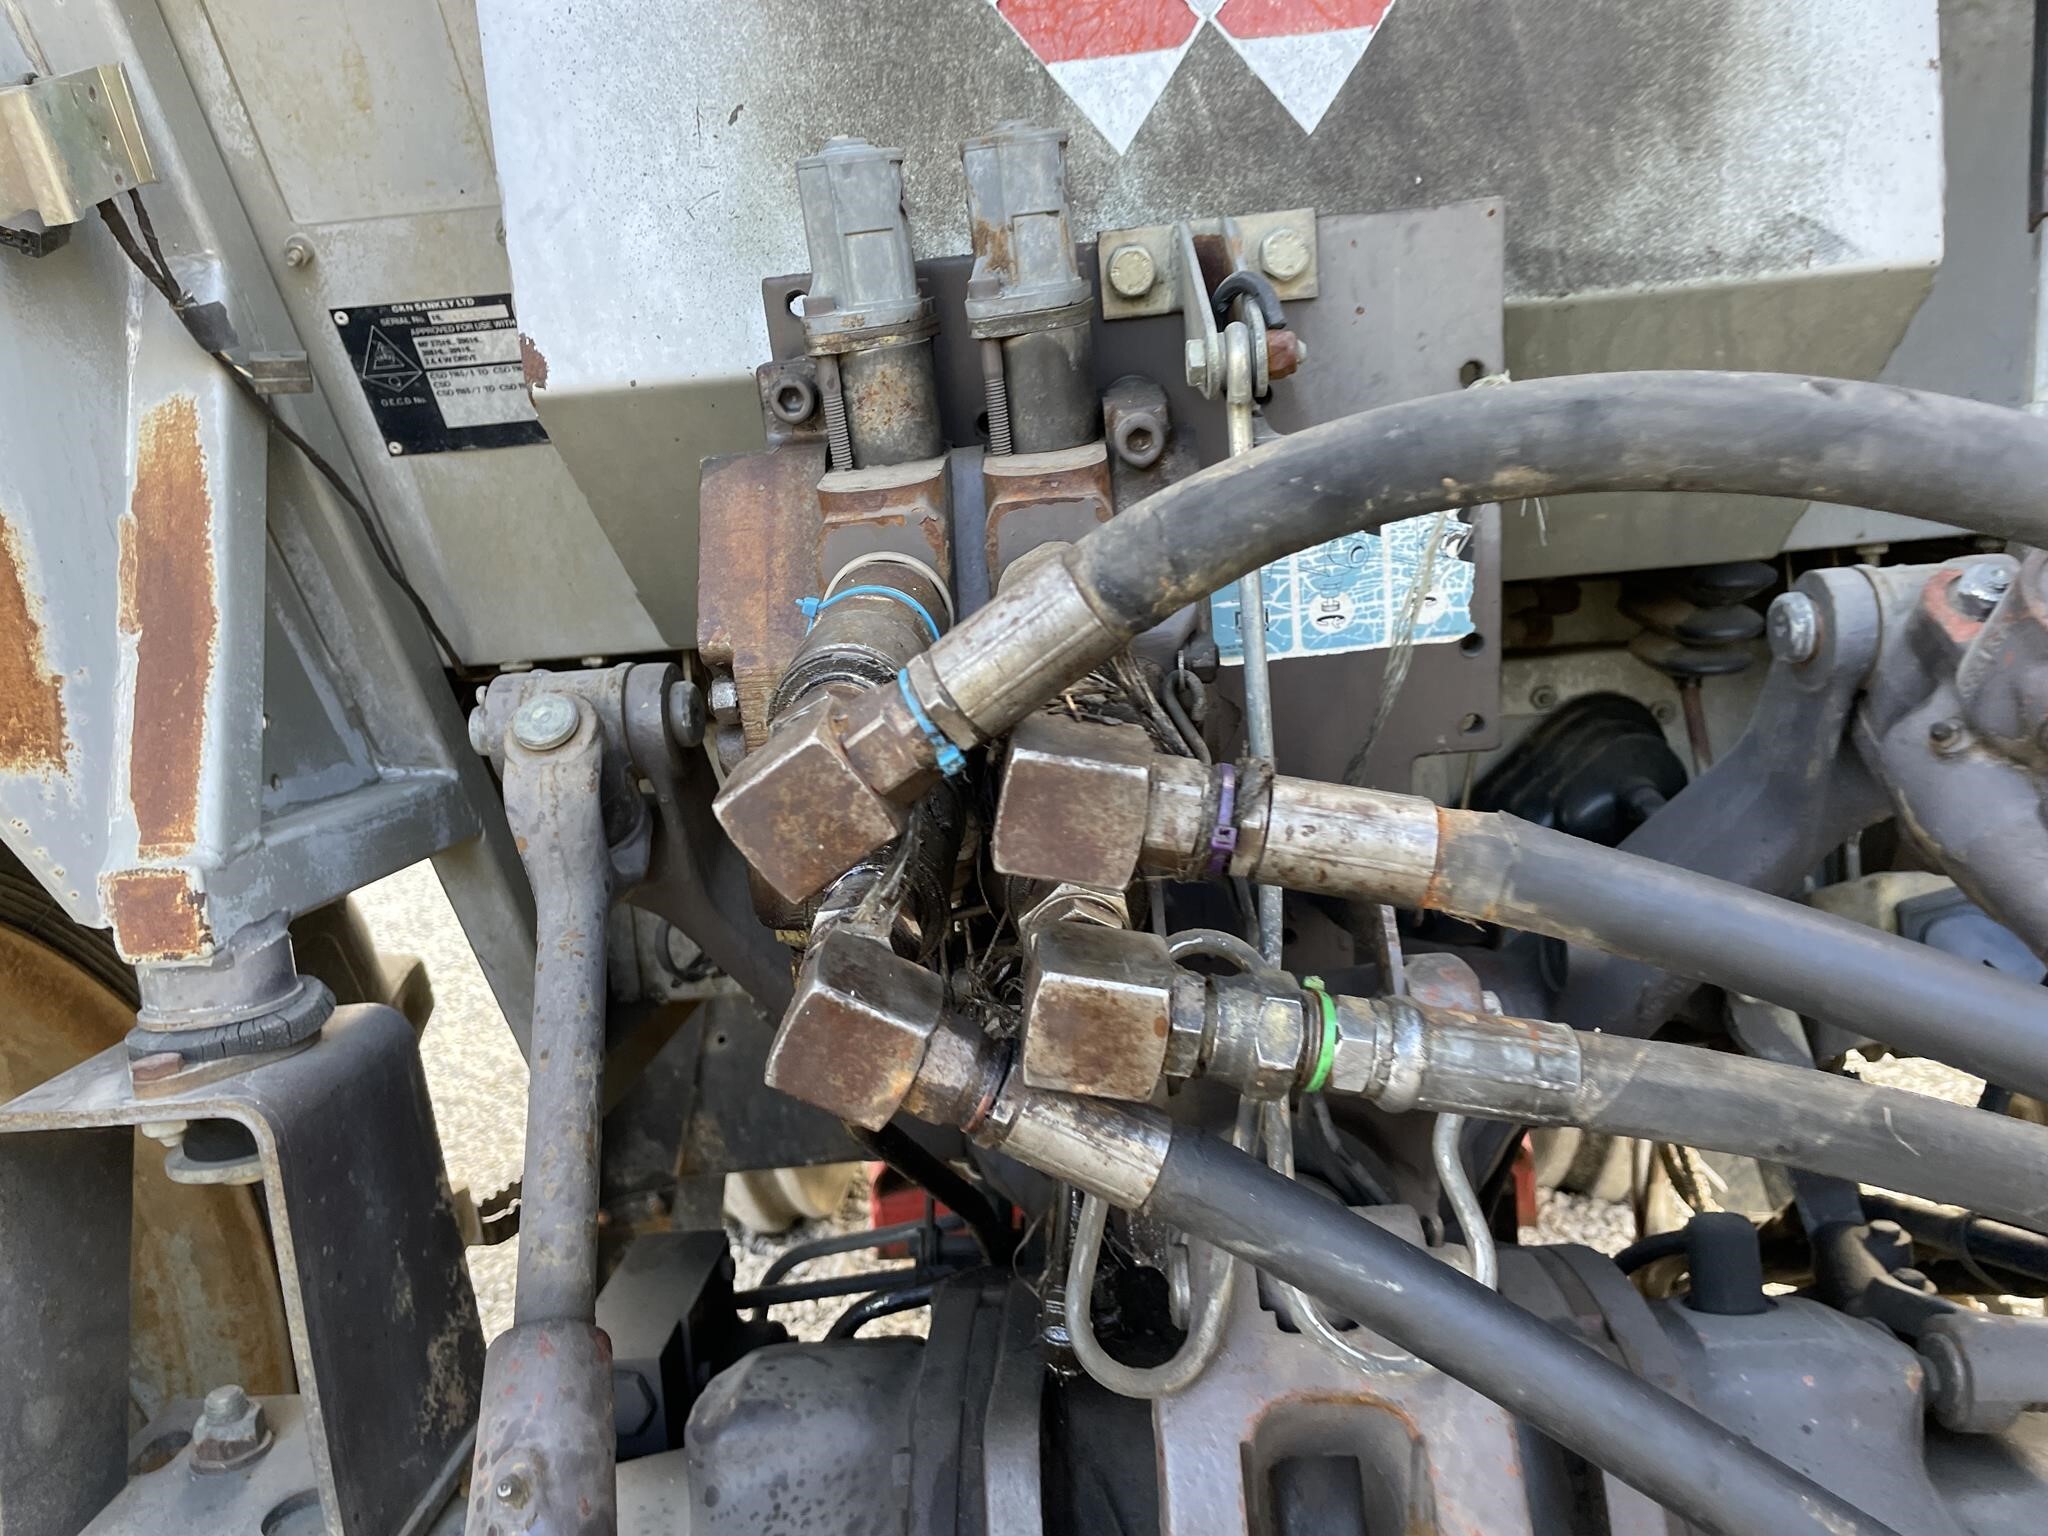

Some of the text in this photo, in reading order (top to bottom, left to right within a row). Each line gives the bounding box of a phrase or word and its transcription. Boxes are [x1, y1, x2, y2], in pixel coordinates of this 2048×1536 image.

[457, 298, 475, 308] LTD
[411, 319, 517, 336] APPROVED FOR USE WITH
